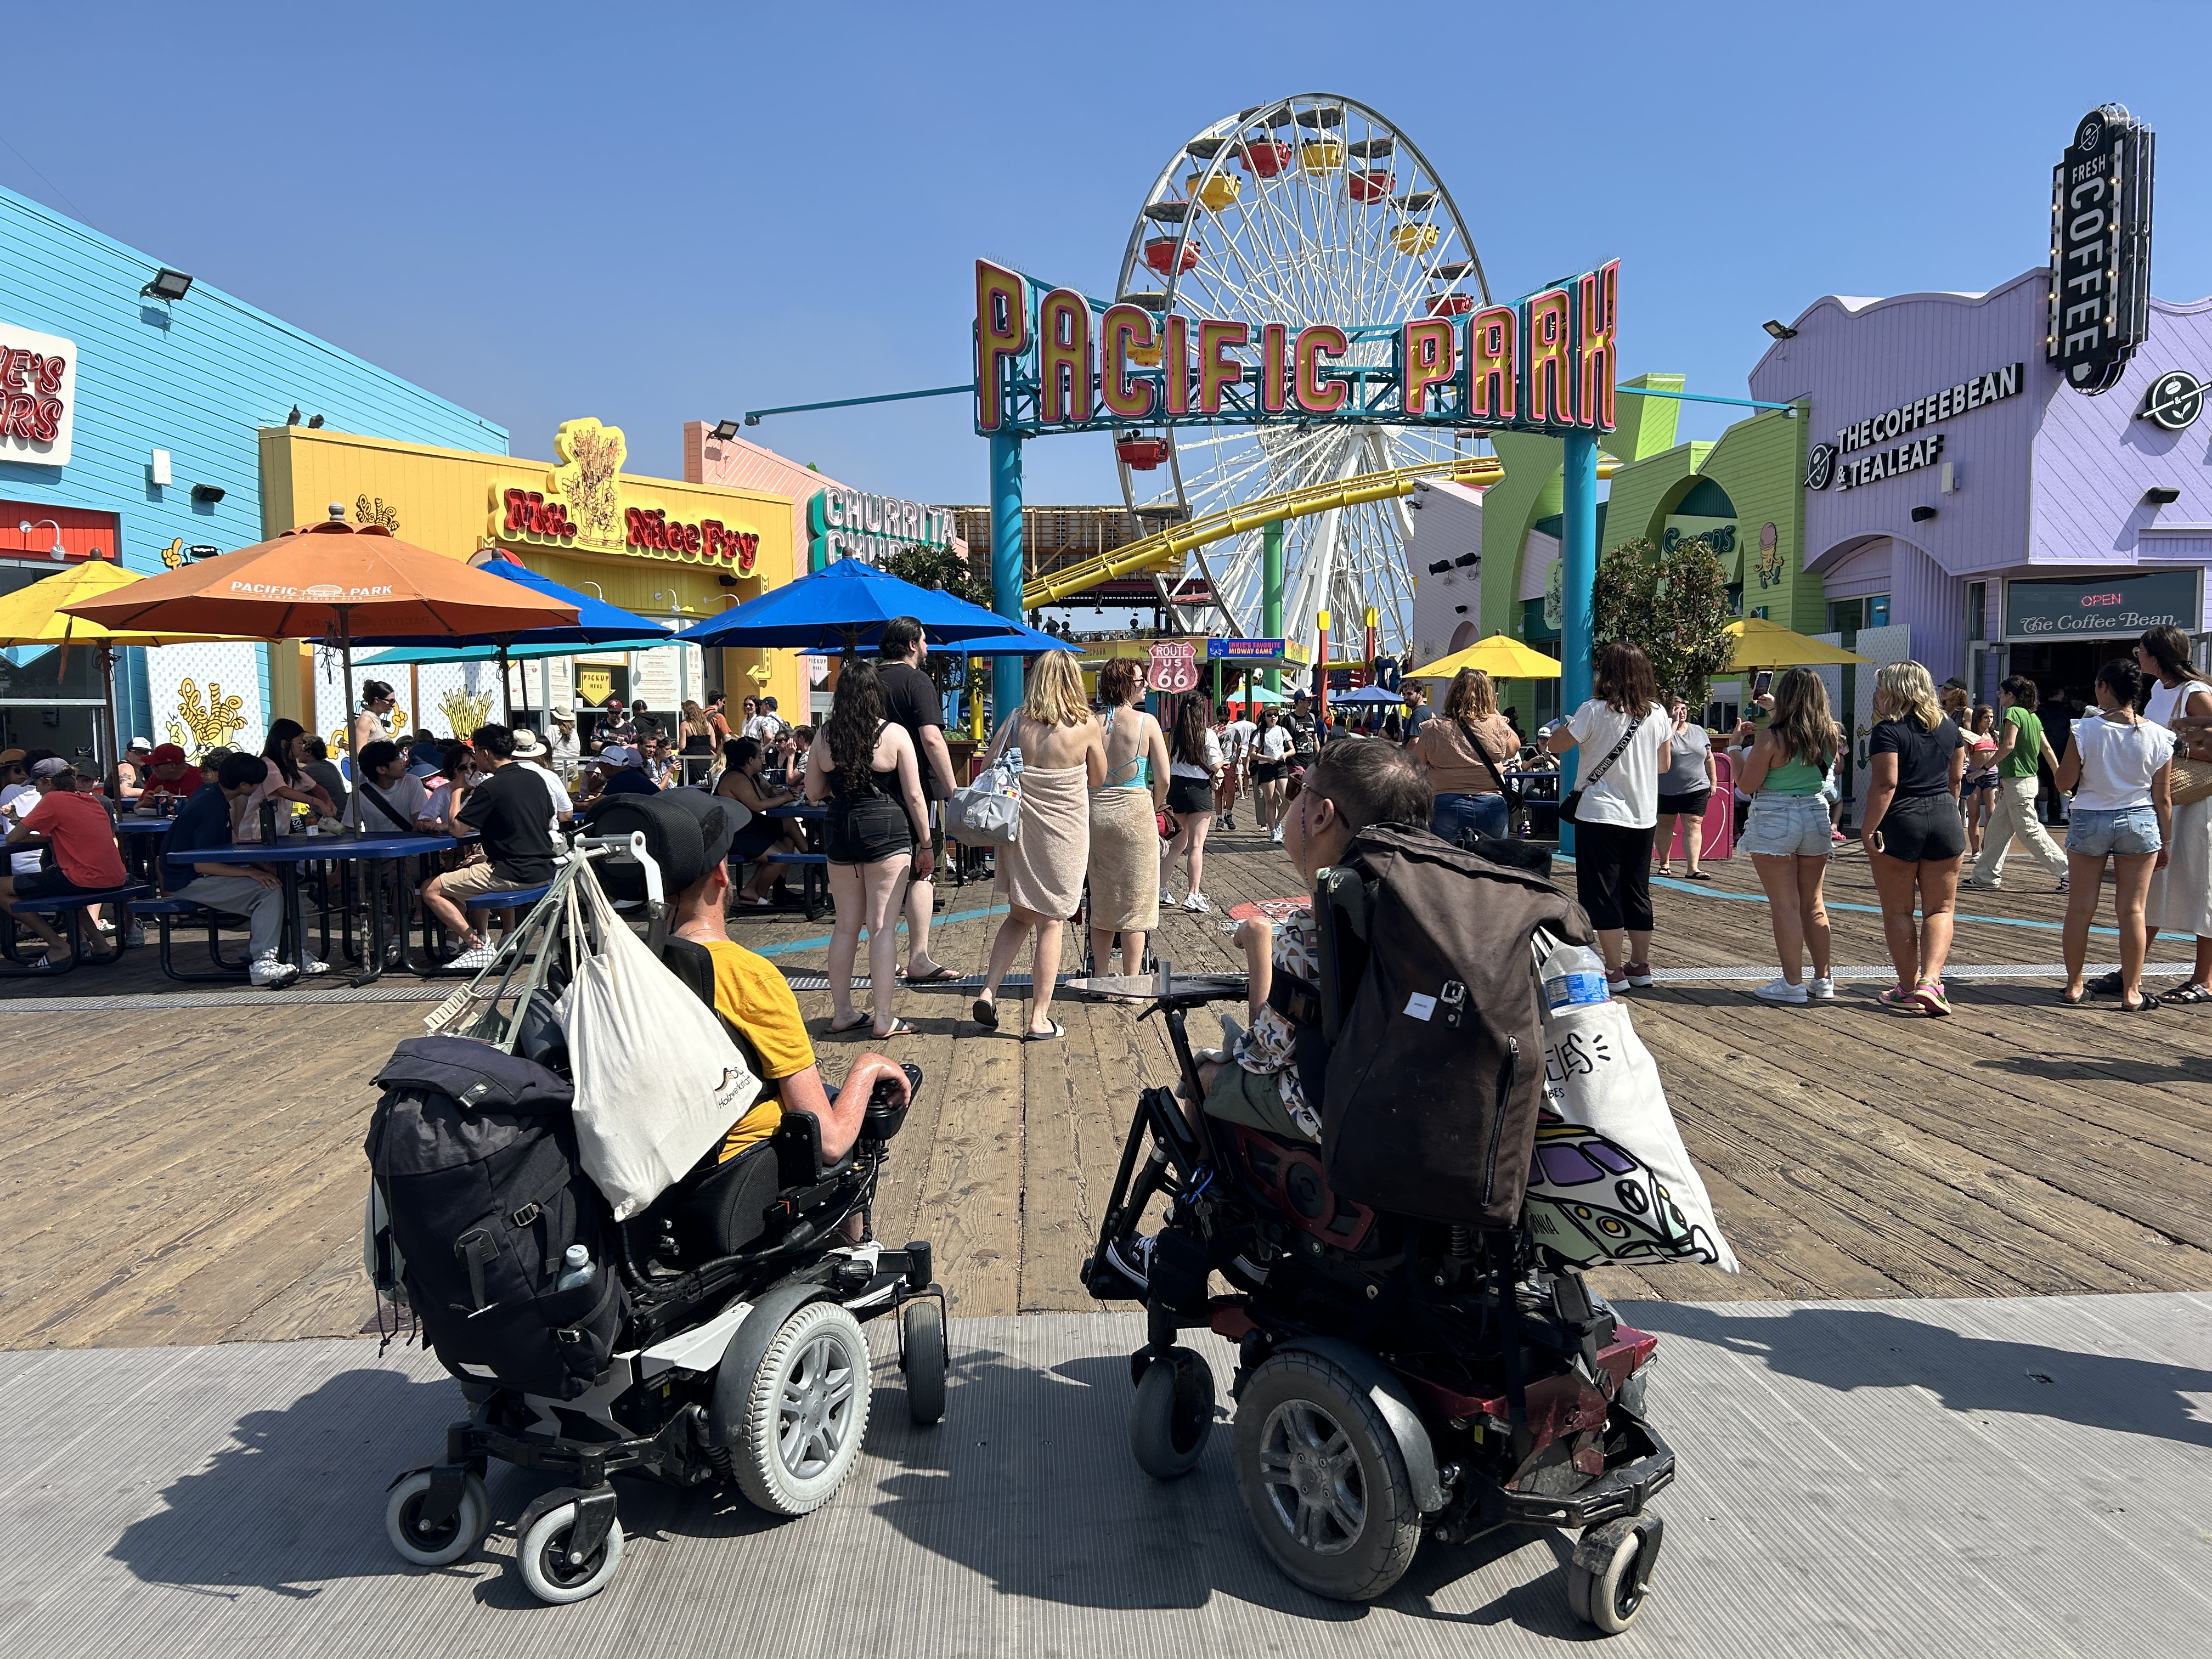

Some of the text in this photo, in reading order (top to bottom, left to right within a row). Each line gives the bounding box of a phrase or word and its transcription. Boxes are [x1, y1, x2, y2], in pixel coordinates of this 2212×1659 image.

[2072, 154, 2106, 184] FRESH
[2064, 176, 2106, 358] COFFEE
[975, 257, 1621, 432] PACIFIC PARK
[0, 388, 64, 442] RS
[504, 488, 760, 569] Mr. Nice Fry
[824, 486, 956, 545] CHURRITA
[826, 529, 939, 566] CHU
[231, 580, 393, 596] PACIFIC PARK
[2081, 593, 2122, 607] OPEN
[2020, 616, 2053, 634] The
[2057, 613, 2117, 630] Coffee
[1156, 646, 1189, 656] ROUTE
[1158, 668, 1189, 688] 66
[1613, 736, 1630, 754] LOLA
[1591, 758, 1612, 780] BIMBA
[1545, 1033, 1593, 1082] ELES
